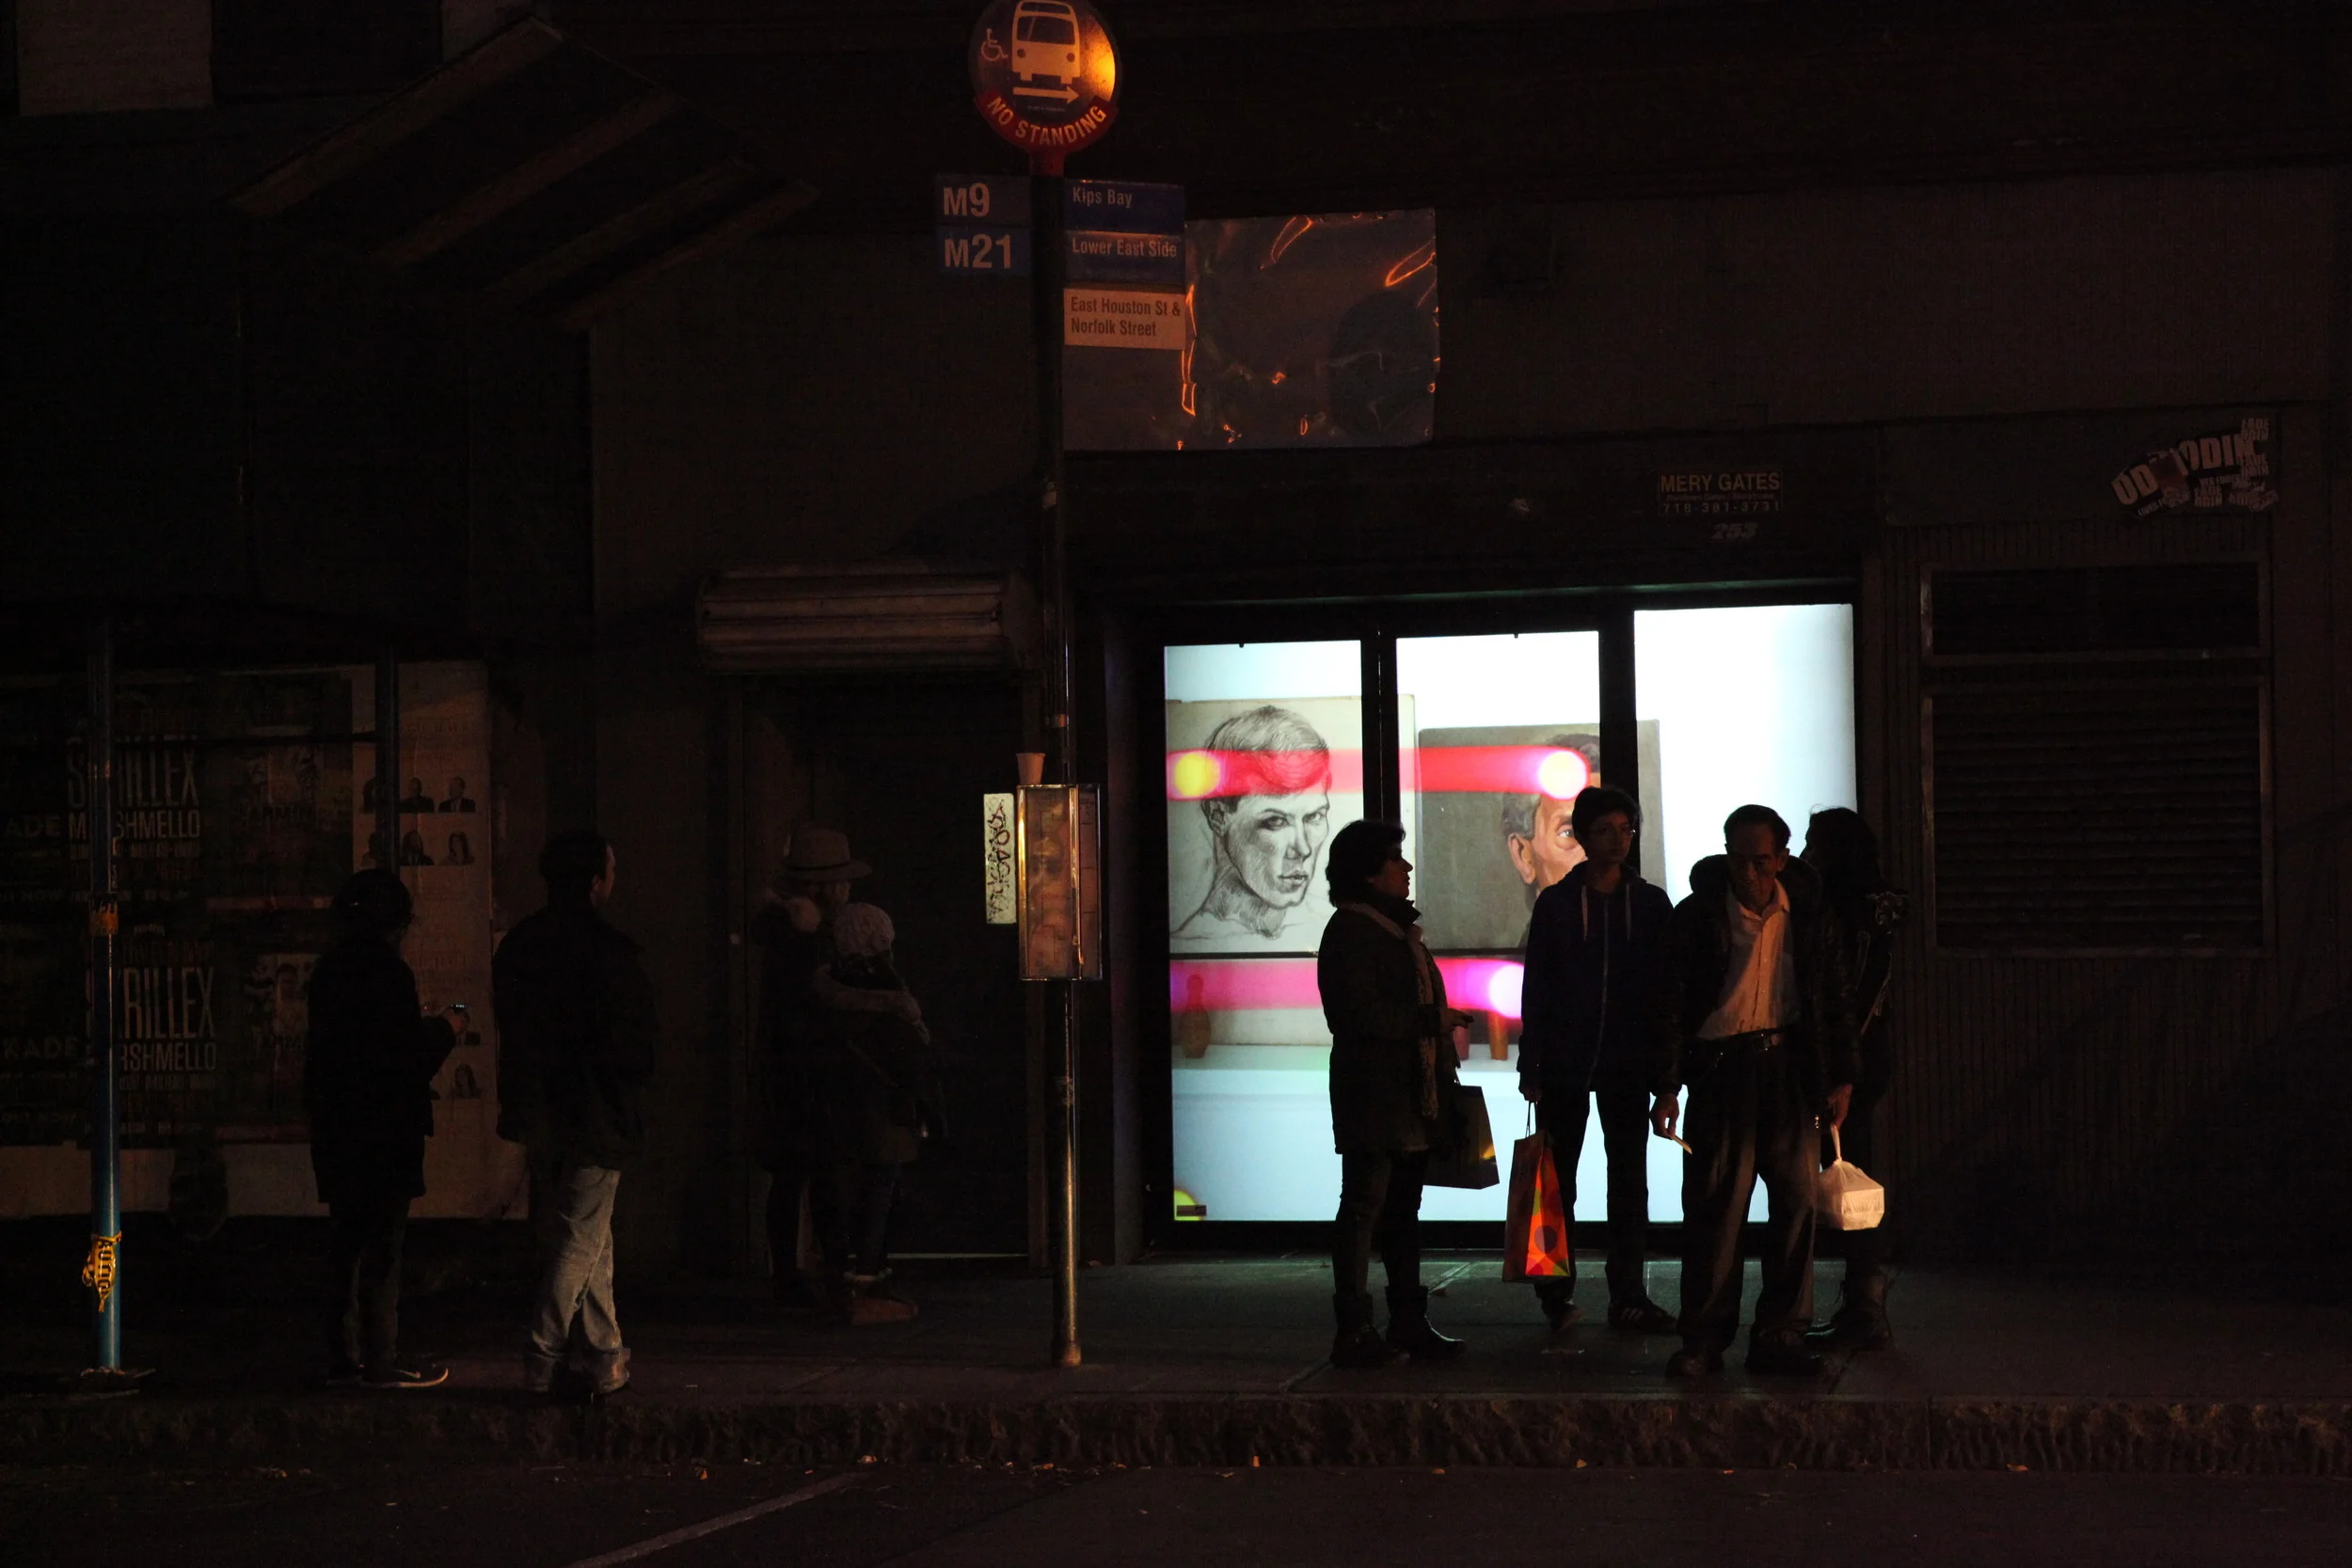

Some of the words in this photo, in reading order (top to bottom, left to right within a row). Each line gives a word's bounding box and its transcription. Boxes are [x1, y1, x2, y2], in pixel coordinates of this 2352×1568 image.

[987, 96, 1014, 125] NO
[1015, 104, 1107, 146] STANDING
[943, 182, 990, 216] M9
[1073, 186, 1103, 207] Kips
[1107, 188, 1133, 209] Bay
[944, 233, 1011, 269] M21
[1073, 237, 1112, 255] Lower
[1117, 239, 1144, 257] East
[1148, 240, 1177, 258] Side
[1071, 296, 1097, 313] East
[1102, 297, 1151, 315] Houston
[1155, 300, 1168, 316] St
[1171, 301, 1181, 316] &
[1071, 317, 1116, 334] Norfolk
[1120, 320, 1156, 337] Street
[1661, 473, 1712, 493] MERY
[1718, 472, 1780, 492] GATES
[66, 736, 200, 809] SILLEX
[69, 810, 200, 840] MSHMELLO
[85, 965, 215, 1039] RILLEX
